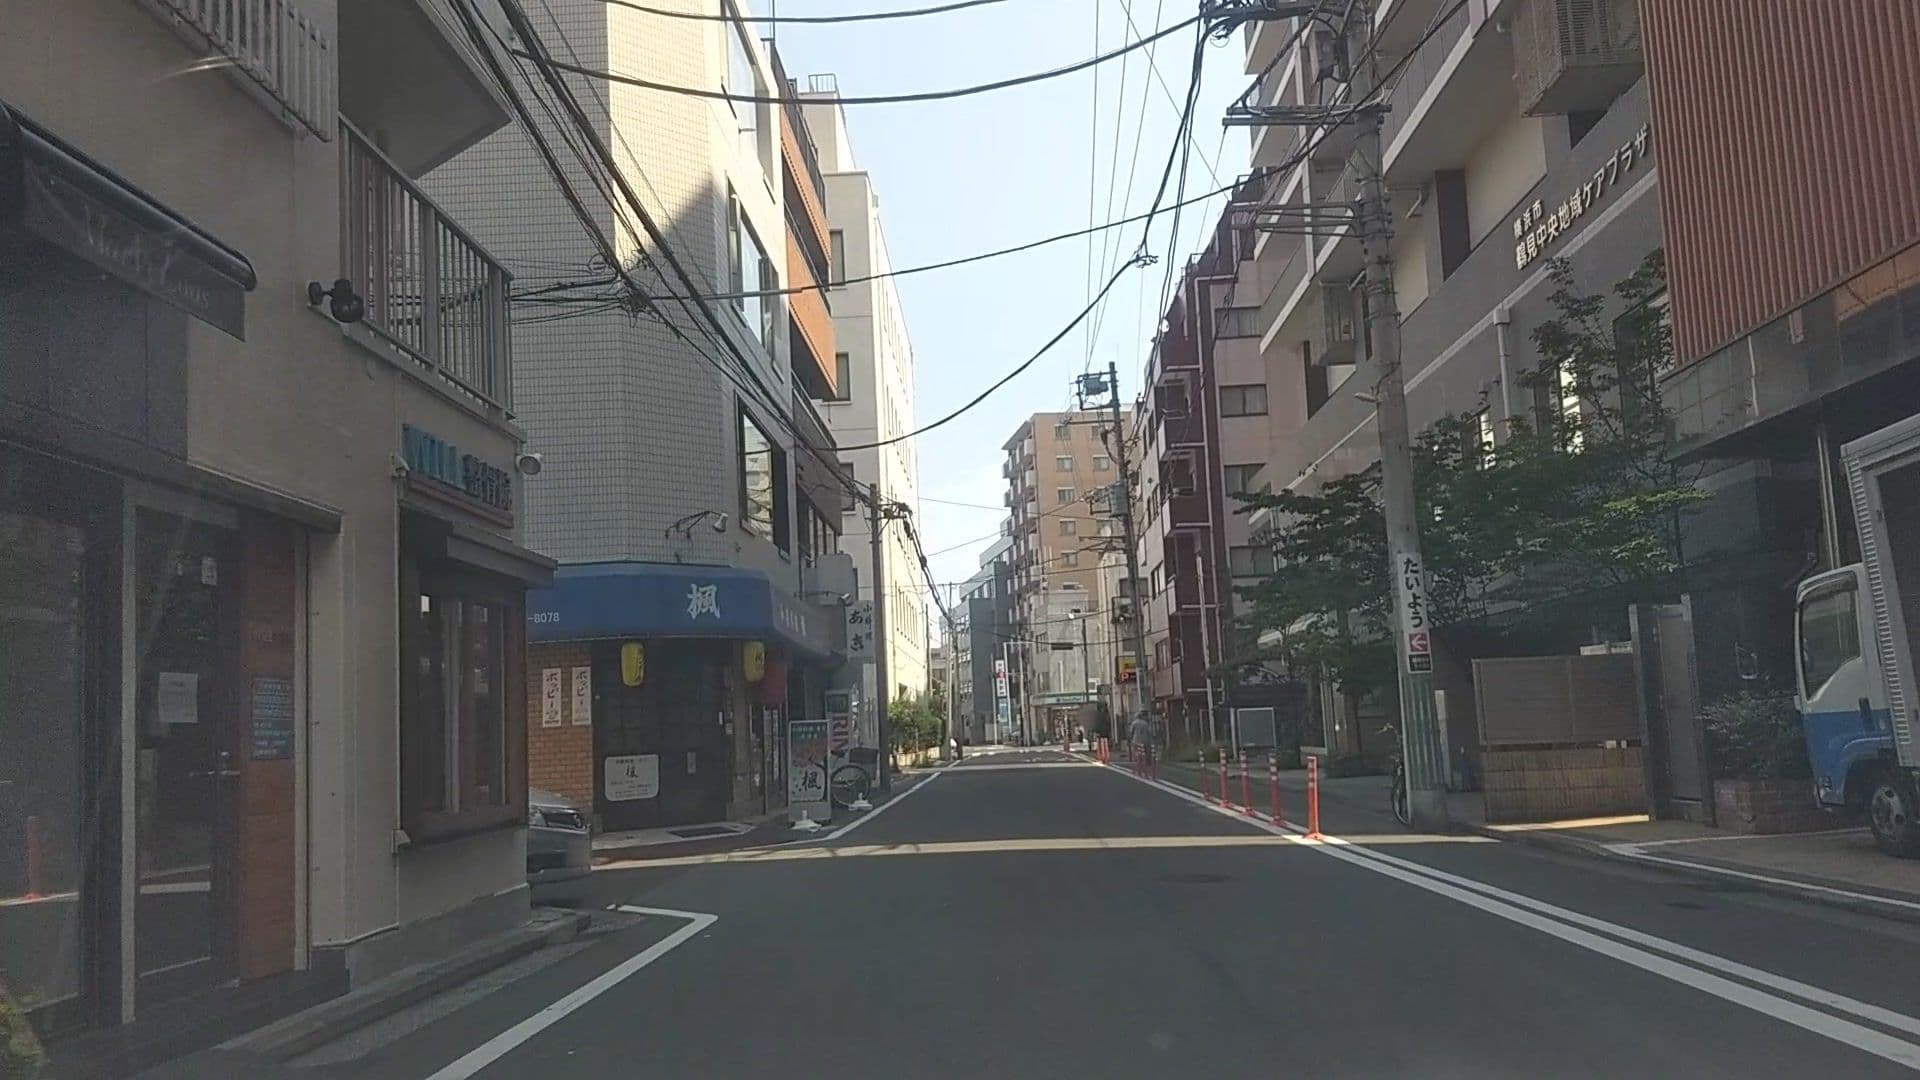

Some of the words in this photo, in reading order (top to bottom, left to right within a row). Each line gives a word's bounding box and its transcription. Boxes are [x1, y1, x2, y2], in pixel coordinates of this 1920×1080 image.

[1512, 199, 1543, 240] 横浜市
[1514, 122, 1650, 270] 鶴見中央地域ケアプラザ
[687, 583, 721, 620] 楓
[1403, 557, 1424, 629] たいよう
